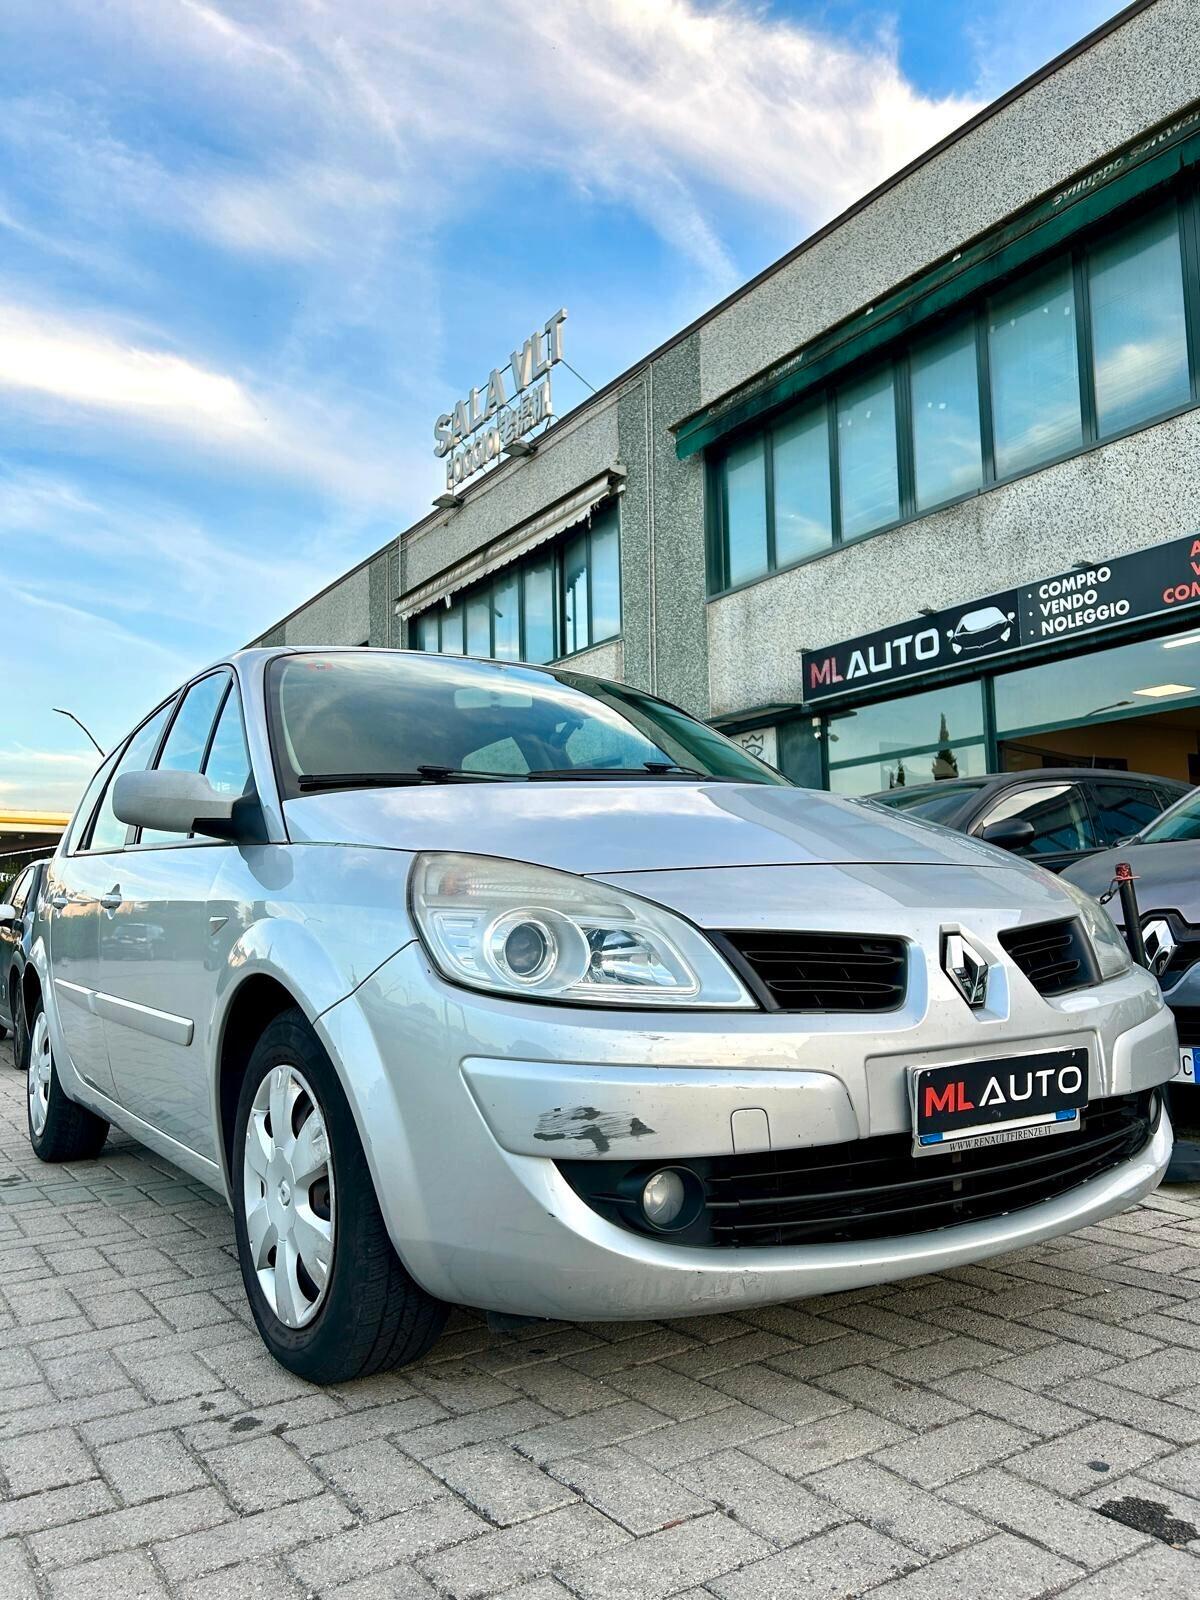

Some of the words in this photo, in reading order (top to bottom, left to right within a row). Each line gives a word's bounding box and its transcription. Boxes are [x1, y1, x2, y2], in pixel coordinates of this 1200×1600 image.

[433, 367, 507, 458] SALA
[510, 307, 568, 393] VLT
[1038, 566, 1112, 599] COMPRO
[1040, 589, 1098, 617] VENDO
[1041, 599, 1130, 636] NOLEGGIO
[811, 657, 844, 689] ML
[846, 627, 940, 680] AUTO
[925, 1081, 975, 1118] ML
[978, 1065, 1083, 1108] AUTO
